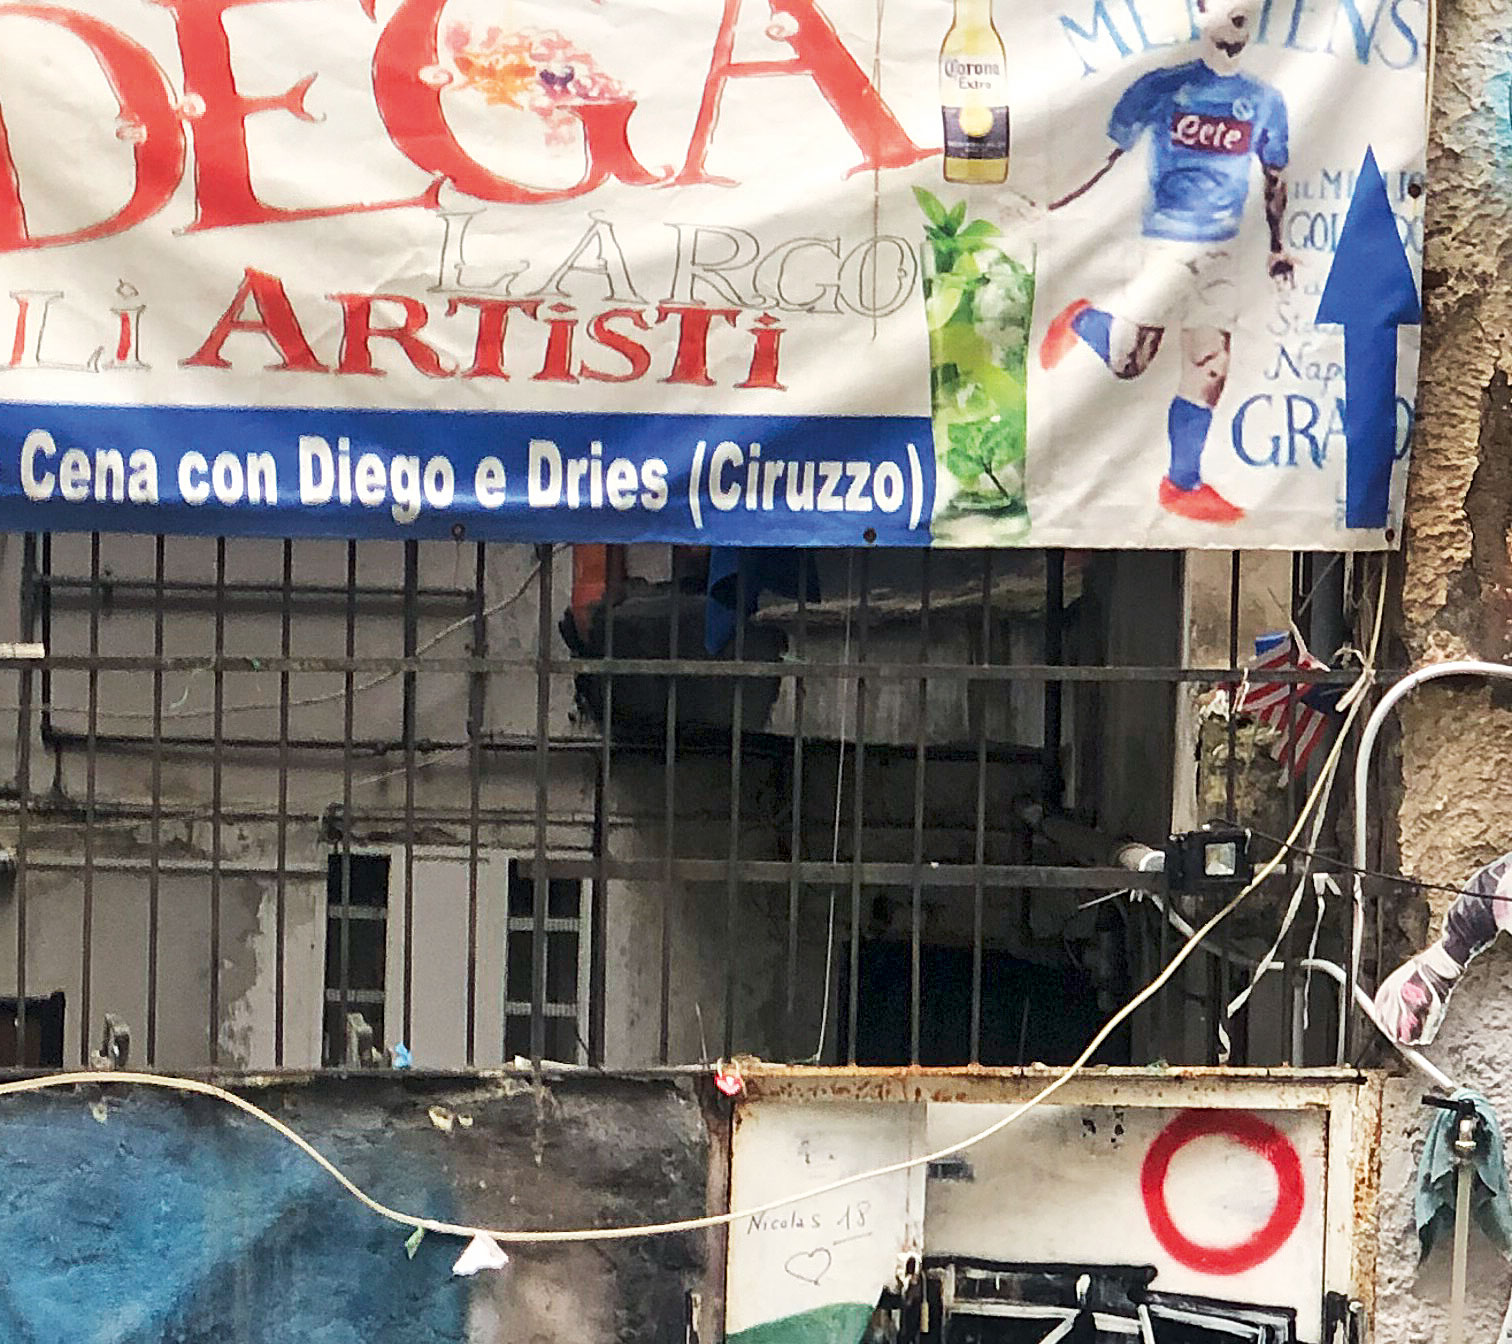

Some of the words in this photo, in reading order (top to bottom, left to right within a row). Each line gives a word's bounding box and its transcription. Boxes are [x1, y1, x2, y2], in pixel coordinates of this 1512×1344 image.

[945, 59, 1000, 78] Corona
[427, 207, 918, 317] LARGO
[1264, 343, 1346, 396] Nap
[20, 428, 159, 504] Cena
[177, 450, 278, 506] con
[297, 434, 455, 526] Diego
[474, 456, 506, 508] e
[527, 437, 669, 512] Dries
[688, 439, 924, 531] (Ciruzzo)
[747, 1209, 821, 1234] Nicolas
